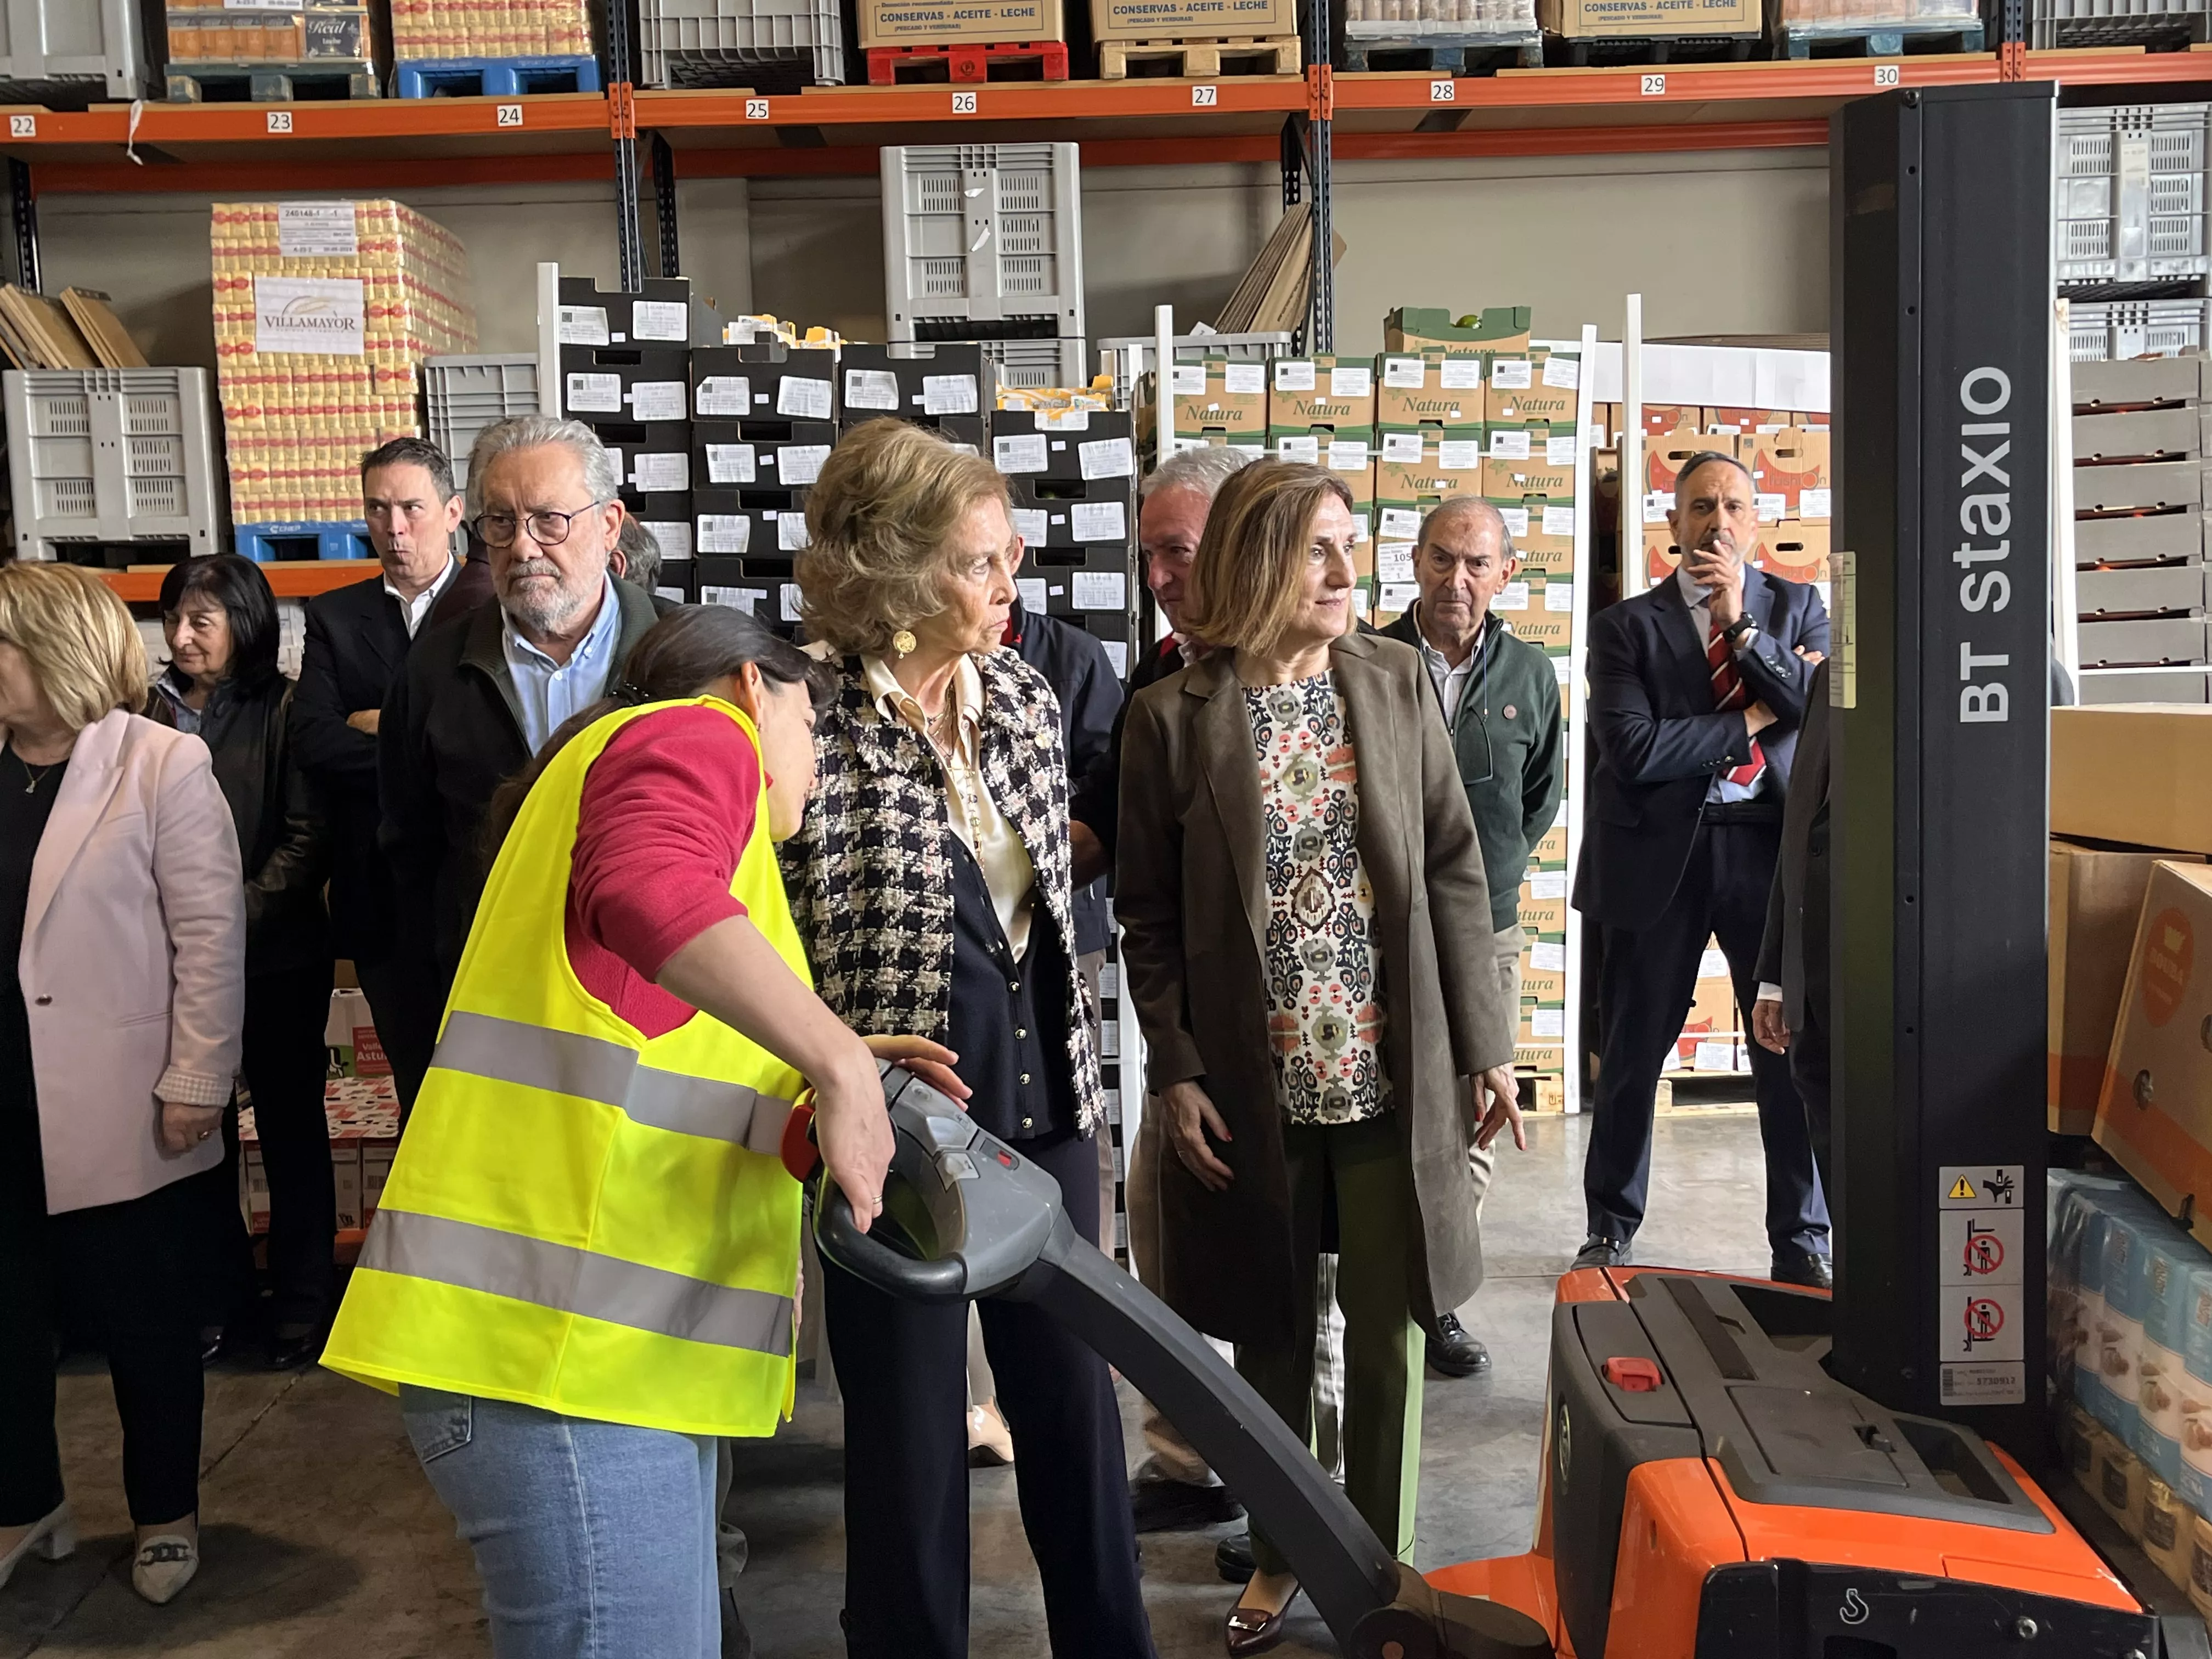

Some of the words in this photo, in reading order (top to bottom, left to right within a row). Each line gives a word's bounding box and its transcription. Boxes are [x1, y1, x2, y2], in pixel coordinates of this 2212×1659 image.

[1113, 4, 1177, 15] CONSERVAS
[1186, 3, 1224, 12] ACEITE
[1233, 1, 1268, 10] LECHE
[1584, 1, 1647, 13] CONSERVAS
[1656, 0, 1693, 10] ACEITE
[1703, 0, 1737, 8] LECHE
[880, 11, 944, 22] CONSERVAS
[953, 9, 991, 19] ACEITE
[1001, 7, 1035, 18] LECHE
[1878, 70, 1897, 83] 30
[1645, 78, 1663, 91] 29
[1195, 89, 1214, 103] 27
[1434, 86, 1452, 99] 28
[748, 103, 766, 117] 25
[955, 96, 973, 110] 26
[271, 115, 290, 128] 23
[500, 109, 519, 122] 24
[15, 119, 31, 132] 22
[264, 315, 356, 330] VILLAMAYOR
[1293, 400, 1351, 416] Natura
[1402, 397, 1460, 412] Natura
[1509, 396, 1566, 411] Natura
[1185, 405, 1243, 421] Natura
[1959, 641, 2010, 723] BT
